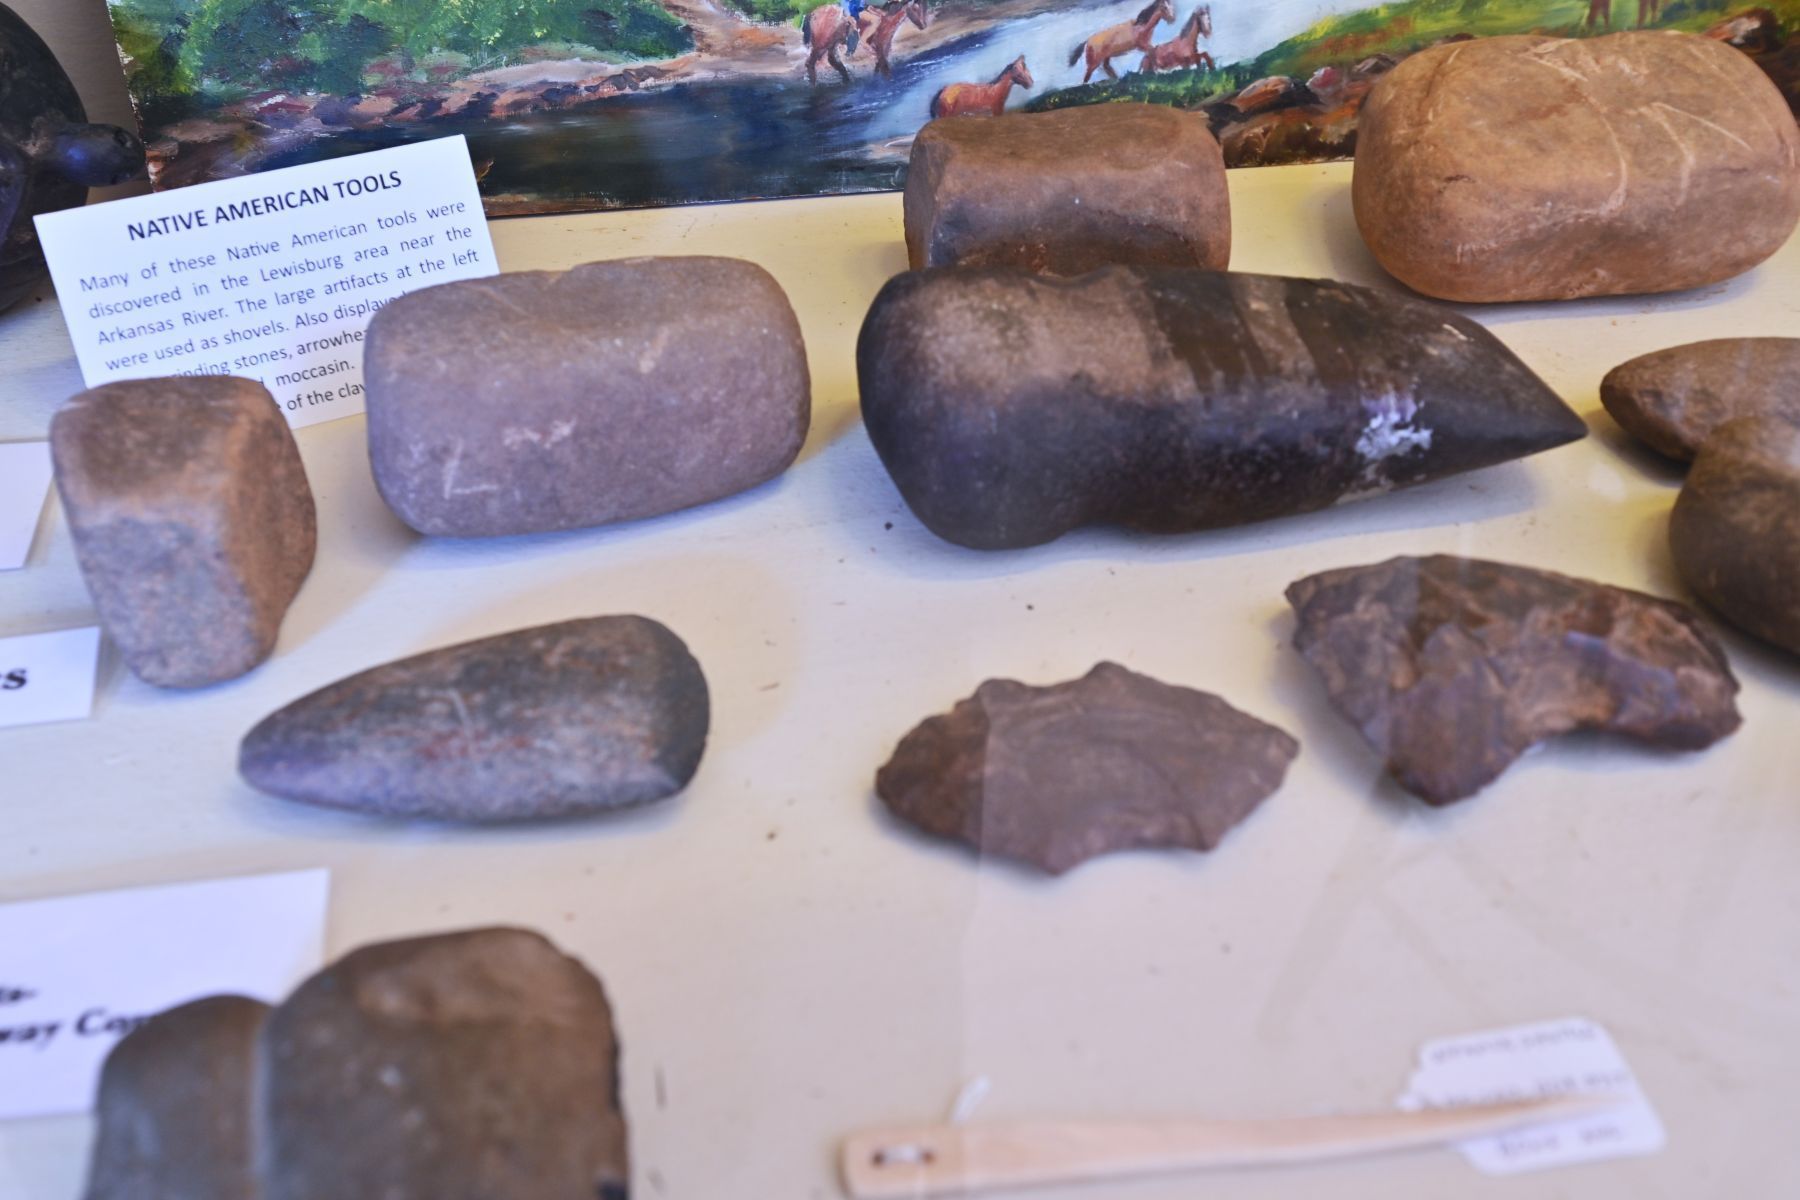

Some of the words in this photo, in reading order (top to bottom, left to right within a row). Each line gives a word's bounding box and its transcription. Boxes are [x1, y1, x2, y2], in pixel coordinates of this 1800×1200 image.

[127, 209, 208, 240] NATIVE
[215, 184, 329, 224] AMERICAN
[334, 170, 402, 198] TOOLS
[80, 272, 129, 292] Many
[140, 261, 159, 280] of
[169, 253, 216, 274] these
[227, 239, 280, 261] Native
[291, 222, 367, 248] American
[377, 209, 417, 230] tools
[427, 201, 465, 218] were
[89, 287, 182, 318] discovered
[193, 282, 209, 296] in
[221, 273, 248, 290] the
[260, 255, 343, 281] Lewisburg
[354, 243, 389, 261] area
[400, 234, 434, 251] near
[445, 224, 472, 242] the
[98, 319, 174, 344] Arkansas
[182, 306, 229, 326] River.
[236, 298, 267, 314] The
[274, 286, 315, 308] large
[324, 271, 388, 295] artifacts
[396, 263, 412, 279] at
[419, 257, 445, 274] the
[452, 248, 480, 266] left
[106, 352, 148, 370] were
[154, 340, 194, 360] used
[201, 336, 218, 350] as
[224, 320, 289, 344] shovels.
[295, 308, 329, 330] Also
[235, 348, 292, 370] stones,
[297, 330, 368, 355] arrowhe
[276, 359, 355, 386] moccasin.
[286, 396, 305, 412] of
[308, 390, 334, 408] the
